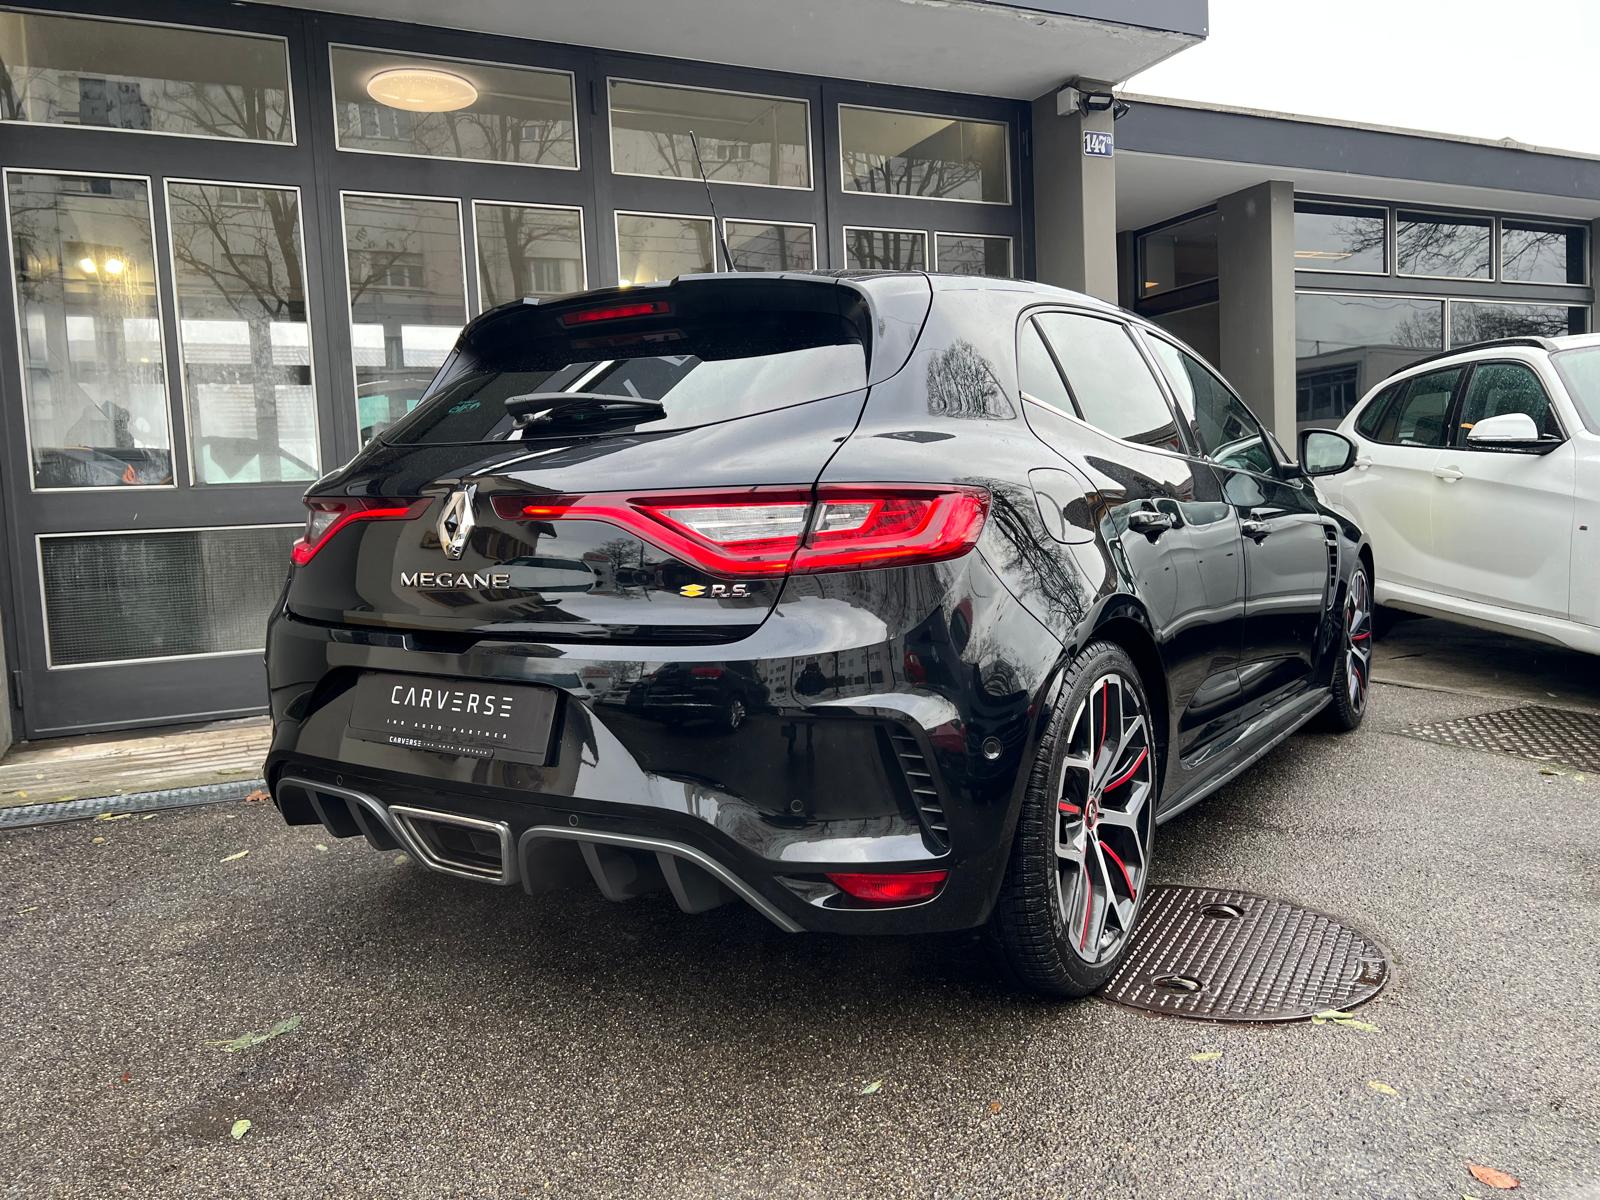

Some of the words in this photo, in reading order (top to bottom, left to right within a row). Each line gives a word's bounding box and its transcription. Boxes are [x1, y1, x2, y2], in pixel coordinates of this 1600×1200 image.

[400, 572, 510, 590] MEGANE
[391, 685, 513, 718] CARVERSE
[389, 736, 422, 747] CARVERSE
